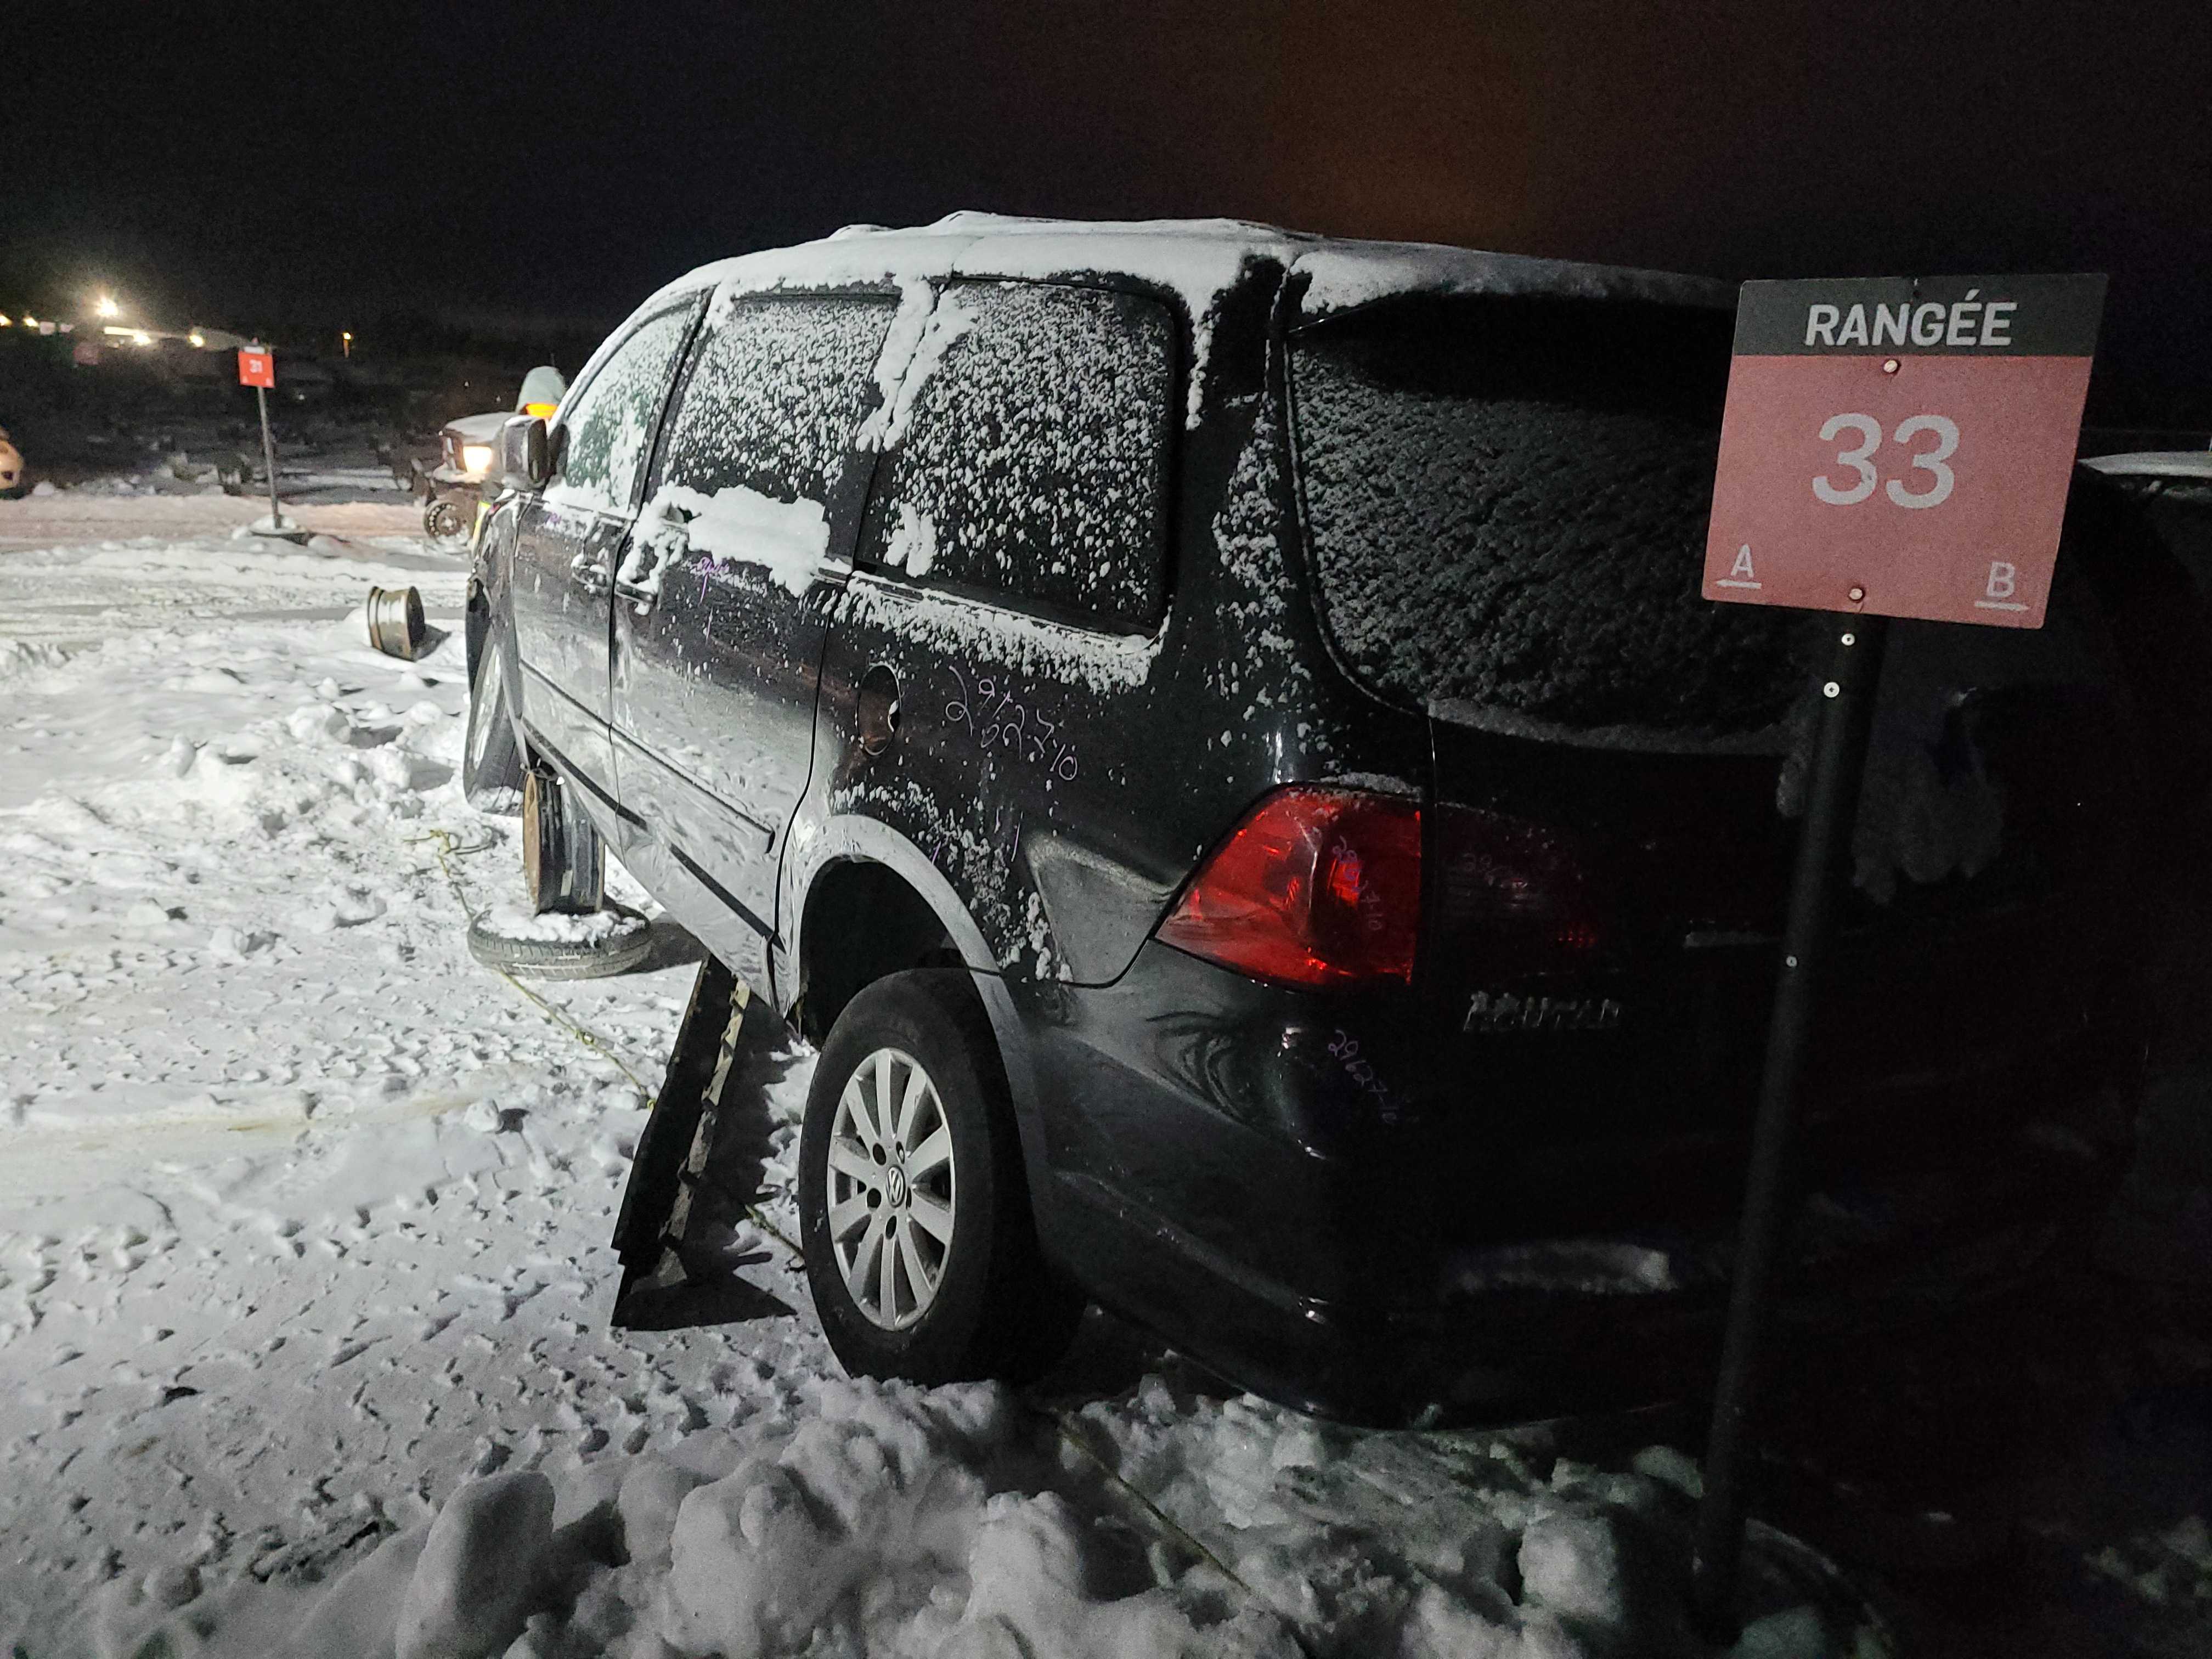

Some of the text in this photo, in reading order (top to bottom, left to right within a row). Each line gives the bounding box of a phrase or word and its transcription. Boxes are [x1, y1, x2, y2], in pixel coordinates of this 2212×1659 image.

[1804, 289, 2017, 347] RANGÉE
[1812, 413, 1960, 509] 33
[1730, 544, 1754, 578] A
[1987, 561, 2015, 597] B
